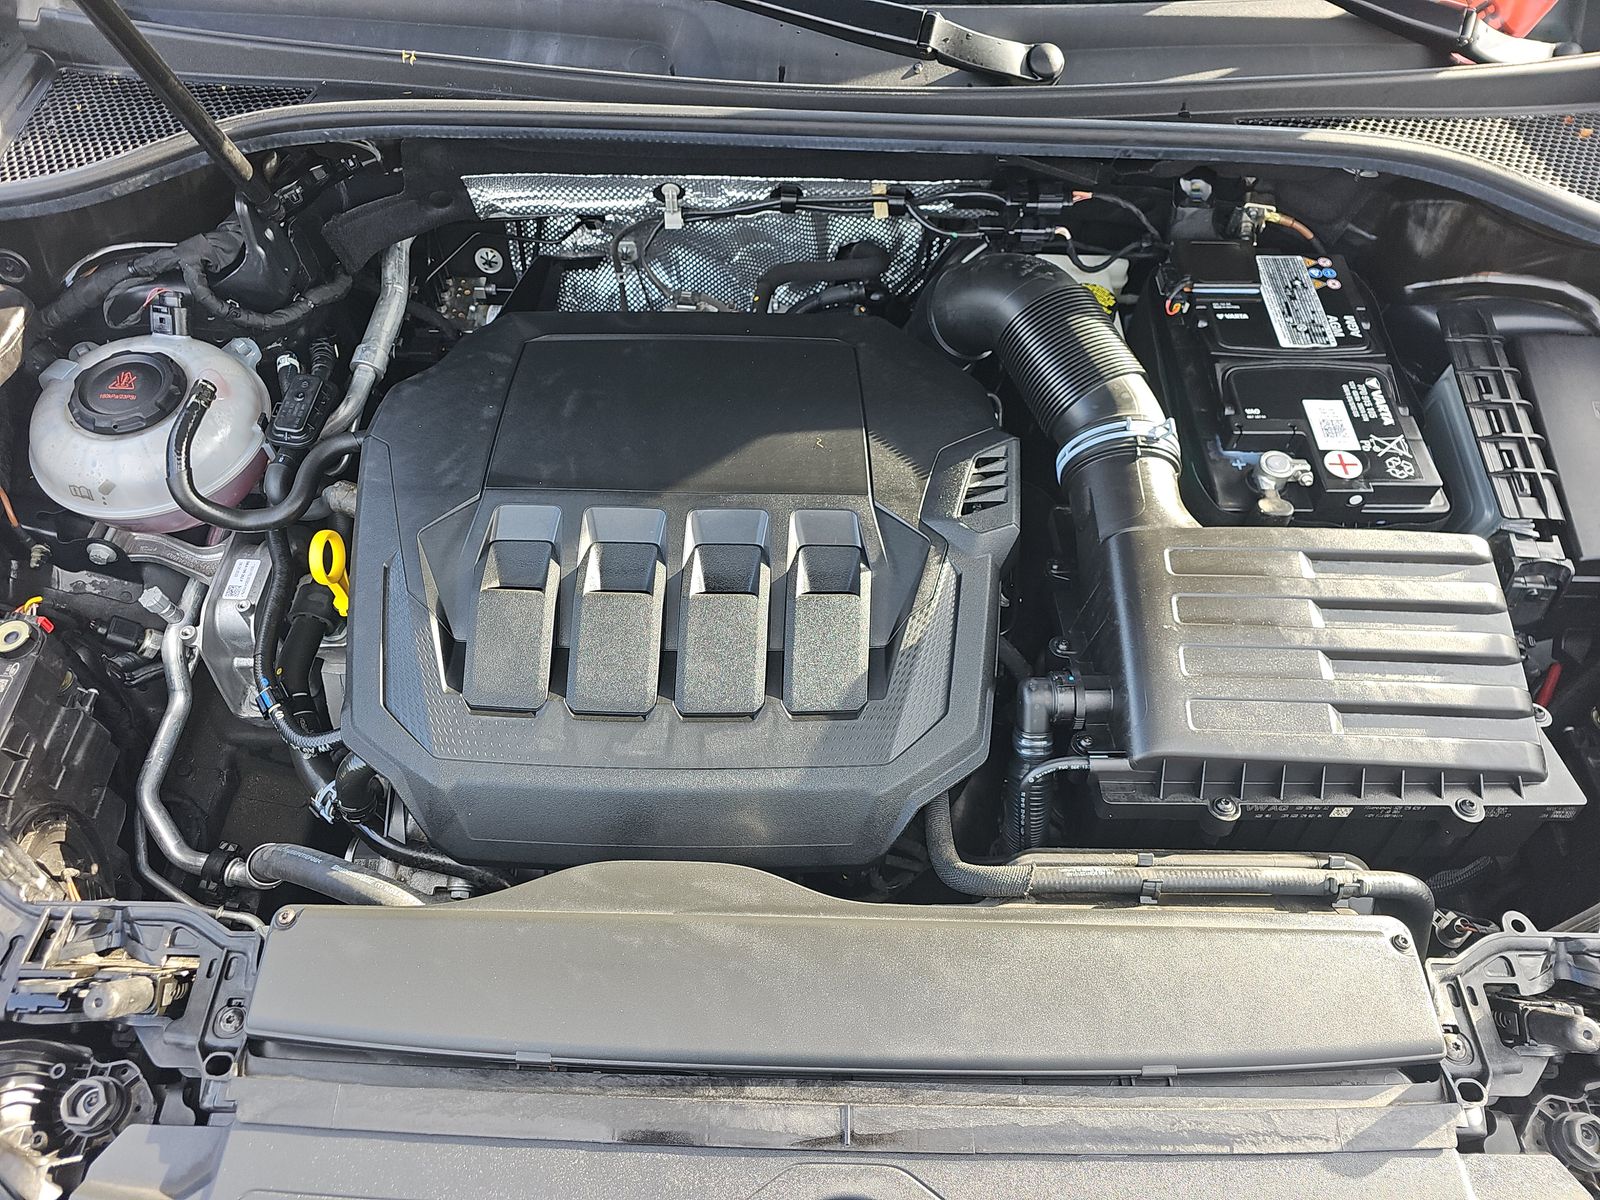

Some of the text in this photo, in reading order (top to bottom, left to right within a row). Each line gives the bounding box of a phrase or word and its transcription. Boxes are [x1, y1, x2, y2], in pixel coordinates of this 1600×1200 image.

[1327, 314, 1345, 338] AGM
[1343, 315, 1363, 338] AGM
[1371, 389, 1395, 426] VARTA
[1359, 440, 1372, 452] Pb
